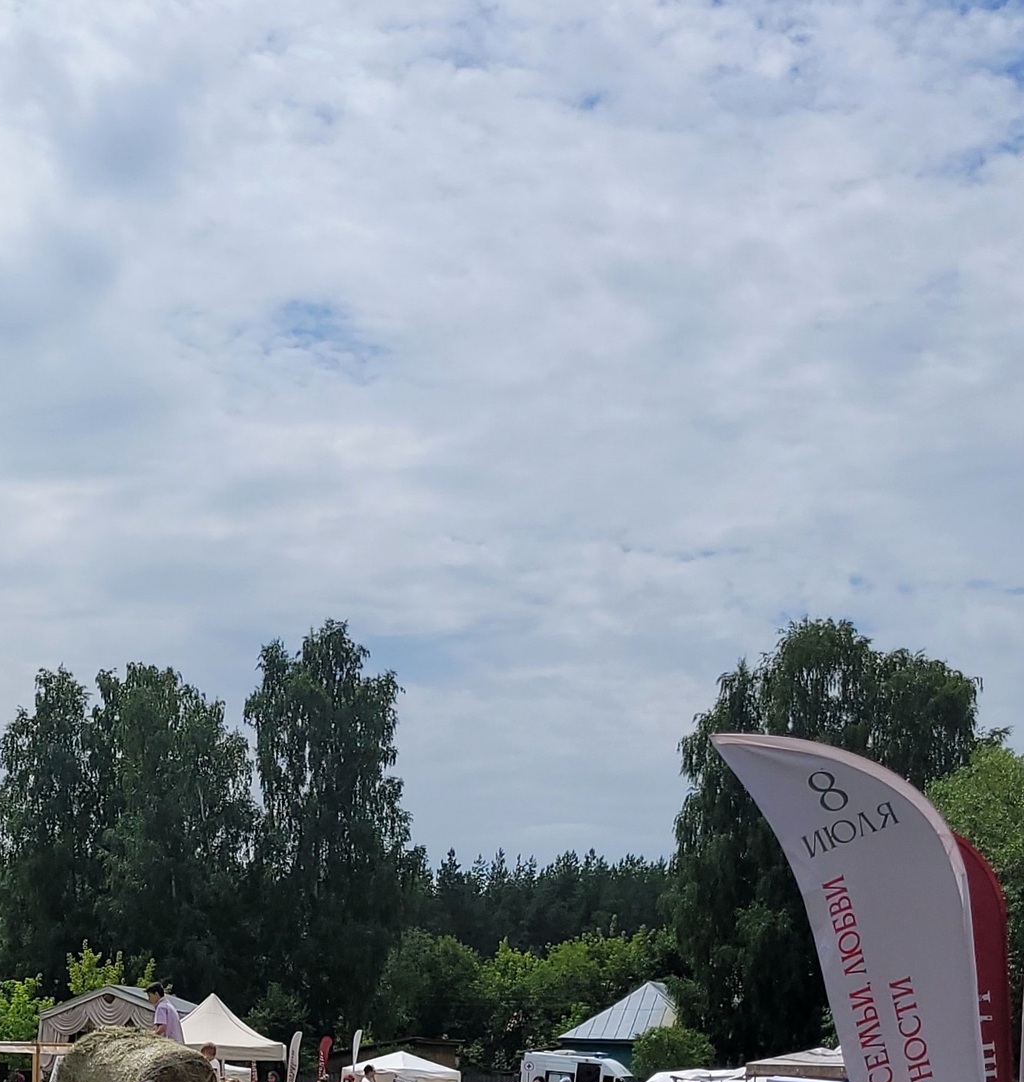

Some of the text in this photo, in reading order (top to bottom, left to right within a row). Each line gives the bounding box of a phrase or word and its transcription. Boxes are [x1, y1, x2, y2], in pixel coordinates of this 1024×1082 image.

[808, 771, 849, 812] 8
[801, 802, 900, 859] ИЮЛЯ
[822, 874, 867, 976] ЛЮБВИ
